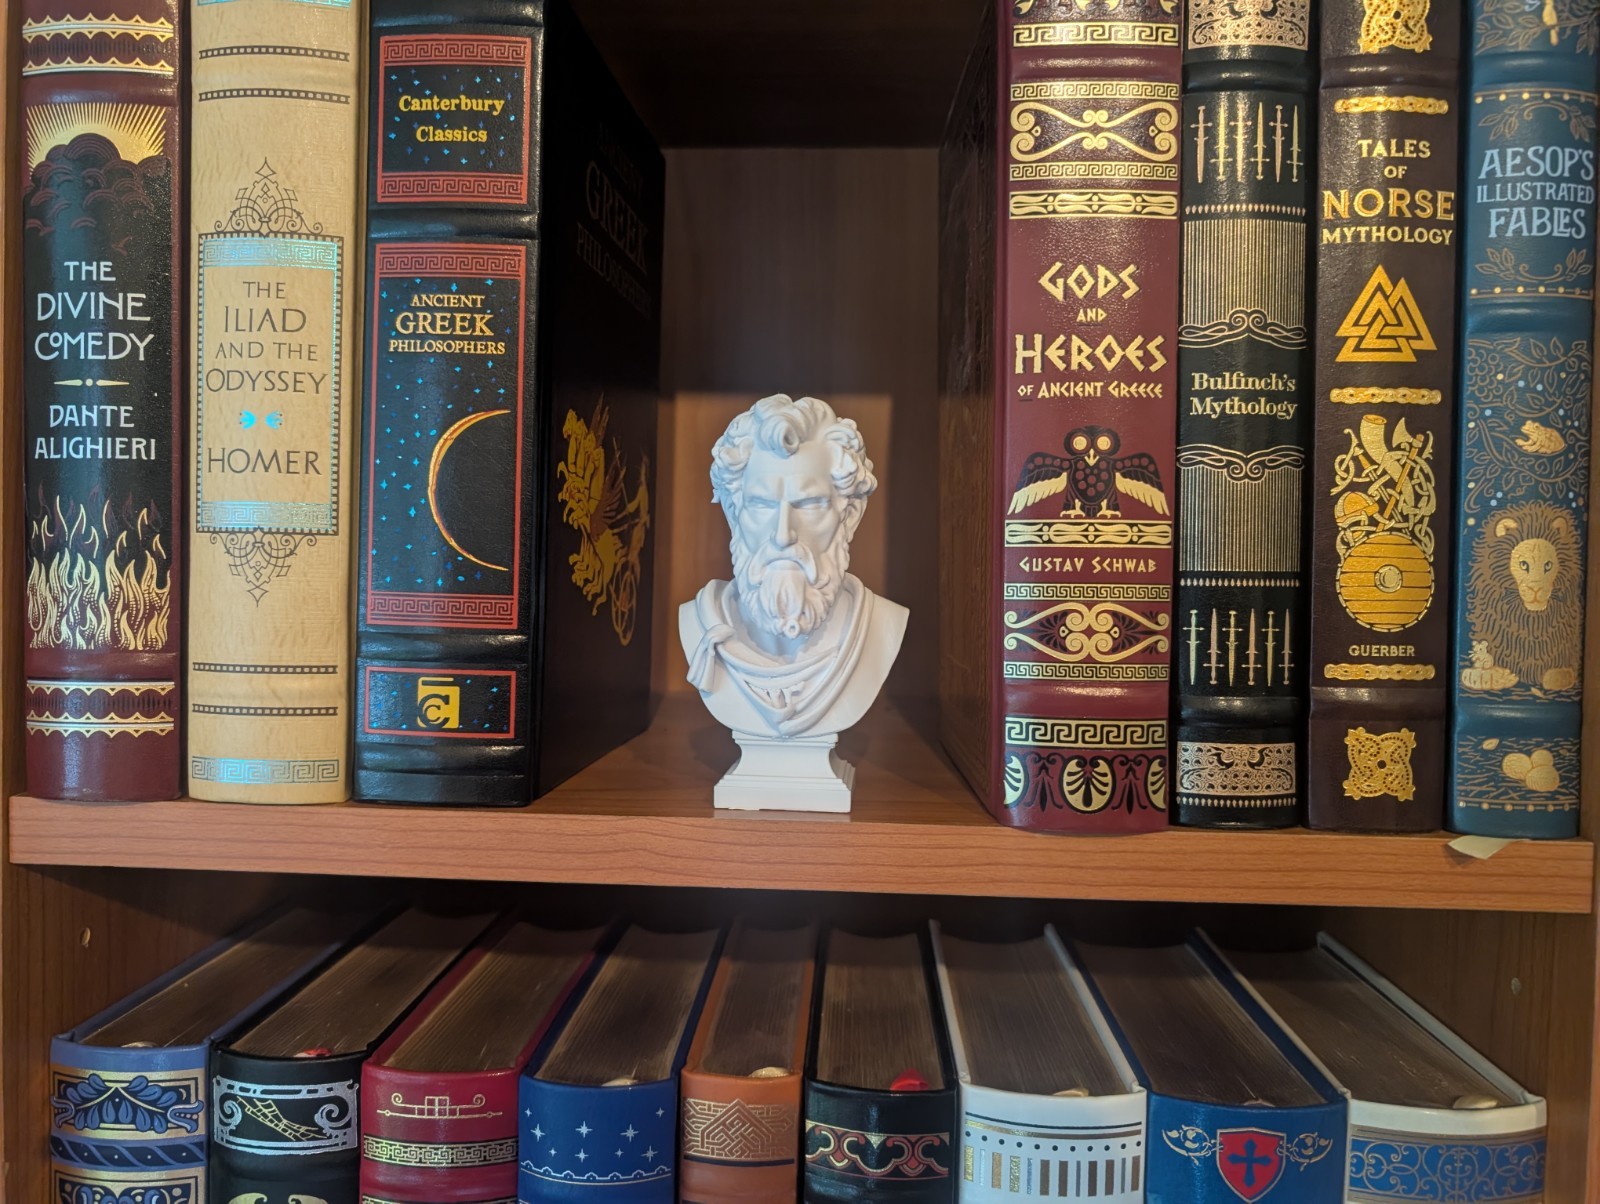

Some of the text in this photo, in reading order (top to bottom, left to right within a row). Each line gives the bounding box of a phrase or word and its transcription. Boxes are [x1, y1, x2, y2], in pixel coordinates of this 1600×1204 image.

[399, 95, 505, 116] Canterbury
[416, 126, 488, 143] Classics
[1357, 138, 1431, 159] TALES
[1384, 165, 1408, 179] OF
[1478, 145, 1595, 182] AESOP'S
[1321, 187, 1455, 221] NORSE
[1476, 182, 1595, 205] ILLUSTRATED
[1488, 206, 1586, 240] FABLES
[1321, 225, 1453, 246] MYTHOLOGY
[64, 261, 117, 282] THE
[1038, 261, 1141, 302] GODS
[242, 281, 287, 300] THE
[409, 293, 486, 309] ANCIENT
[37, 291, 151, 322] DIVINE
[1076, 308, 1108, 323] AND
[224, 306, 307, 333] ILIAD
[395, 311, 495, 337] GREEK
[34, 331, 155, 361] COMEDY
[215, 341, 318, 361] AND THE
[388, 338, 506, 355] PHILOSOPHERS
[1014, 333, 1168, 374] HEROES
[205, 368, 329, 395] ODYSSEY
[1017, 380, 1164, 398] OF ANCIENT GREECE
[1191, 372, 1297, 393] Bulfinch's
[49, 404, 135, 428] DANTE
[1189, 396, 1298, 420] Mythology
[34, 437, 156, 460] ALIGHIERI
[207, 447, 323, 476] HOMER
[1019, 556, 1157, 573] GUSTAV SCHWAB
[1348, 644, 1416, 657] GUERBER
